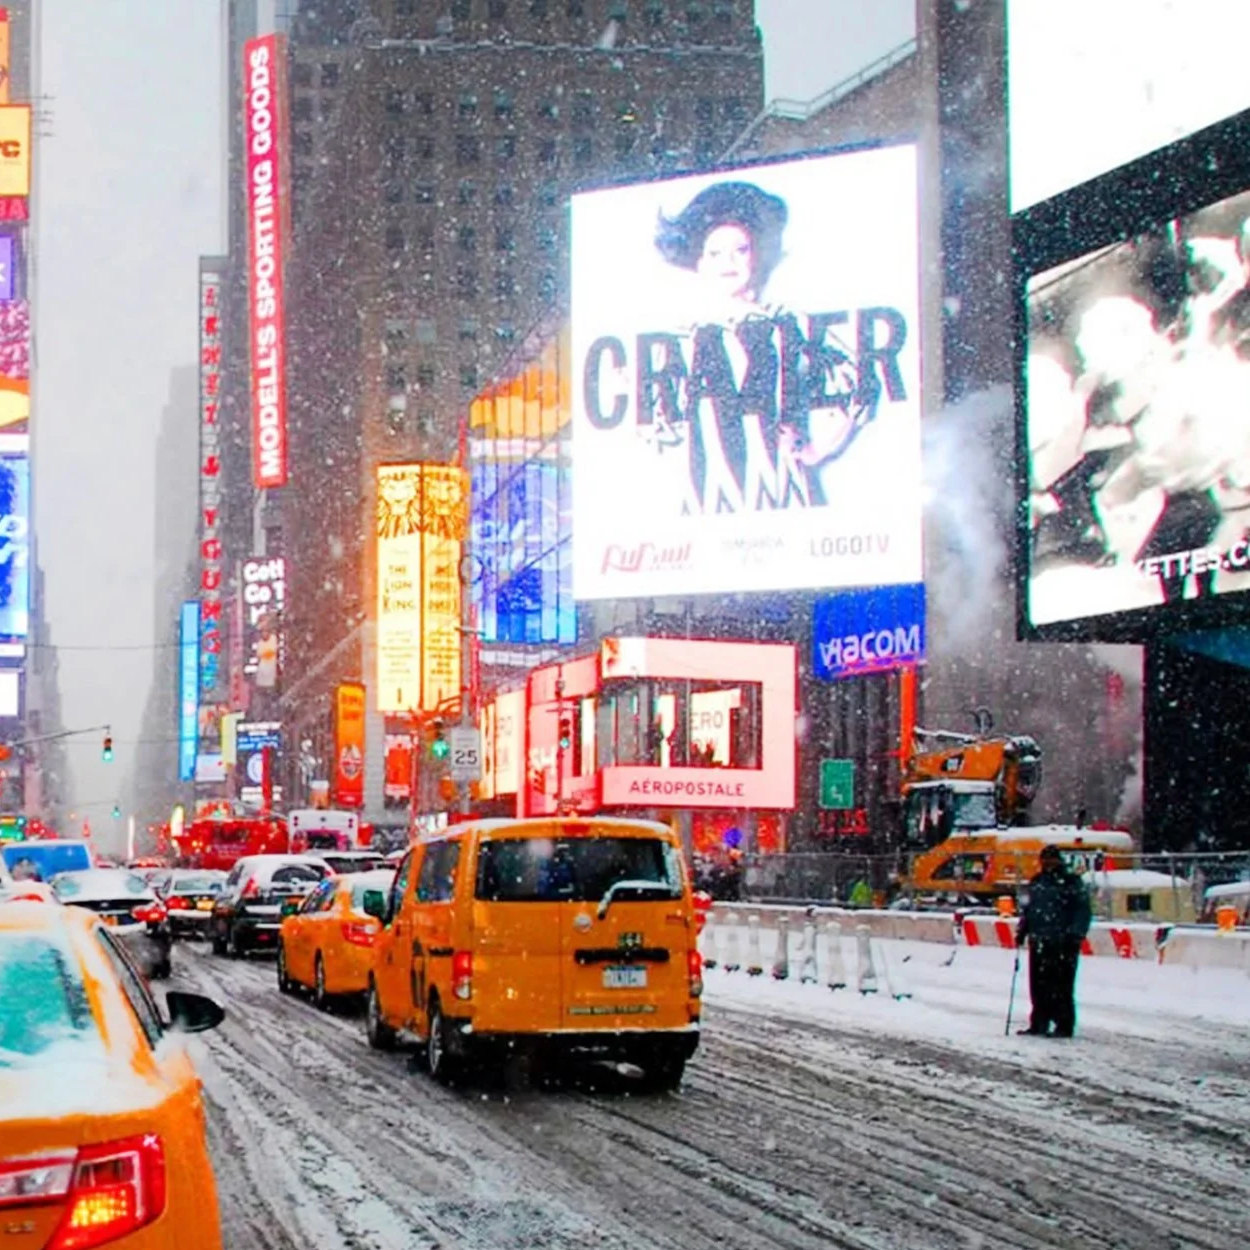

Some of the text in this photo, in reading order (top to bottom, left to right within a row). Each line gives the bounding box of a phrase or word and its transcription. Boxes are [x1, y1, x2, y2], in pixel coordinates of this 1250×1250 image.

[250, 46, 281, 478] MODELL'S SPORTING GOODS
[689, 709, 725, 733] ERO
[454, 750, 478, 765] 25
